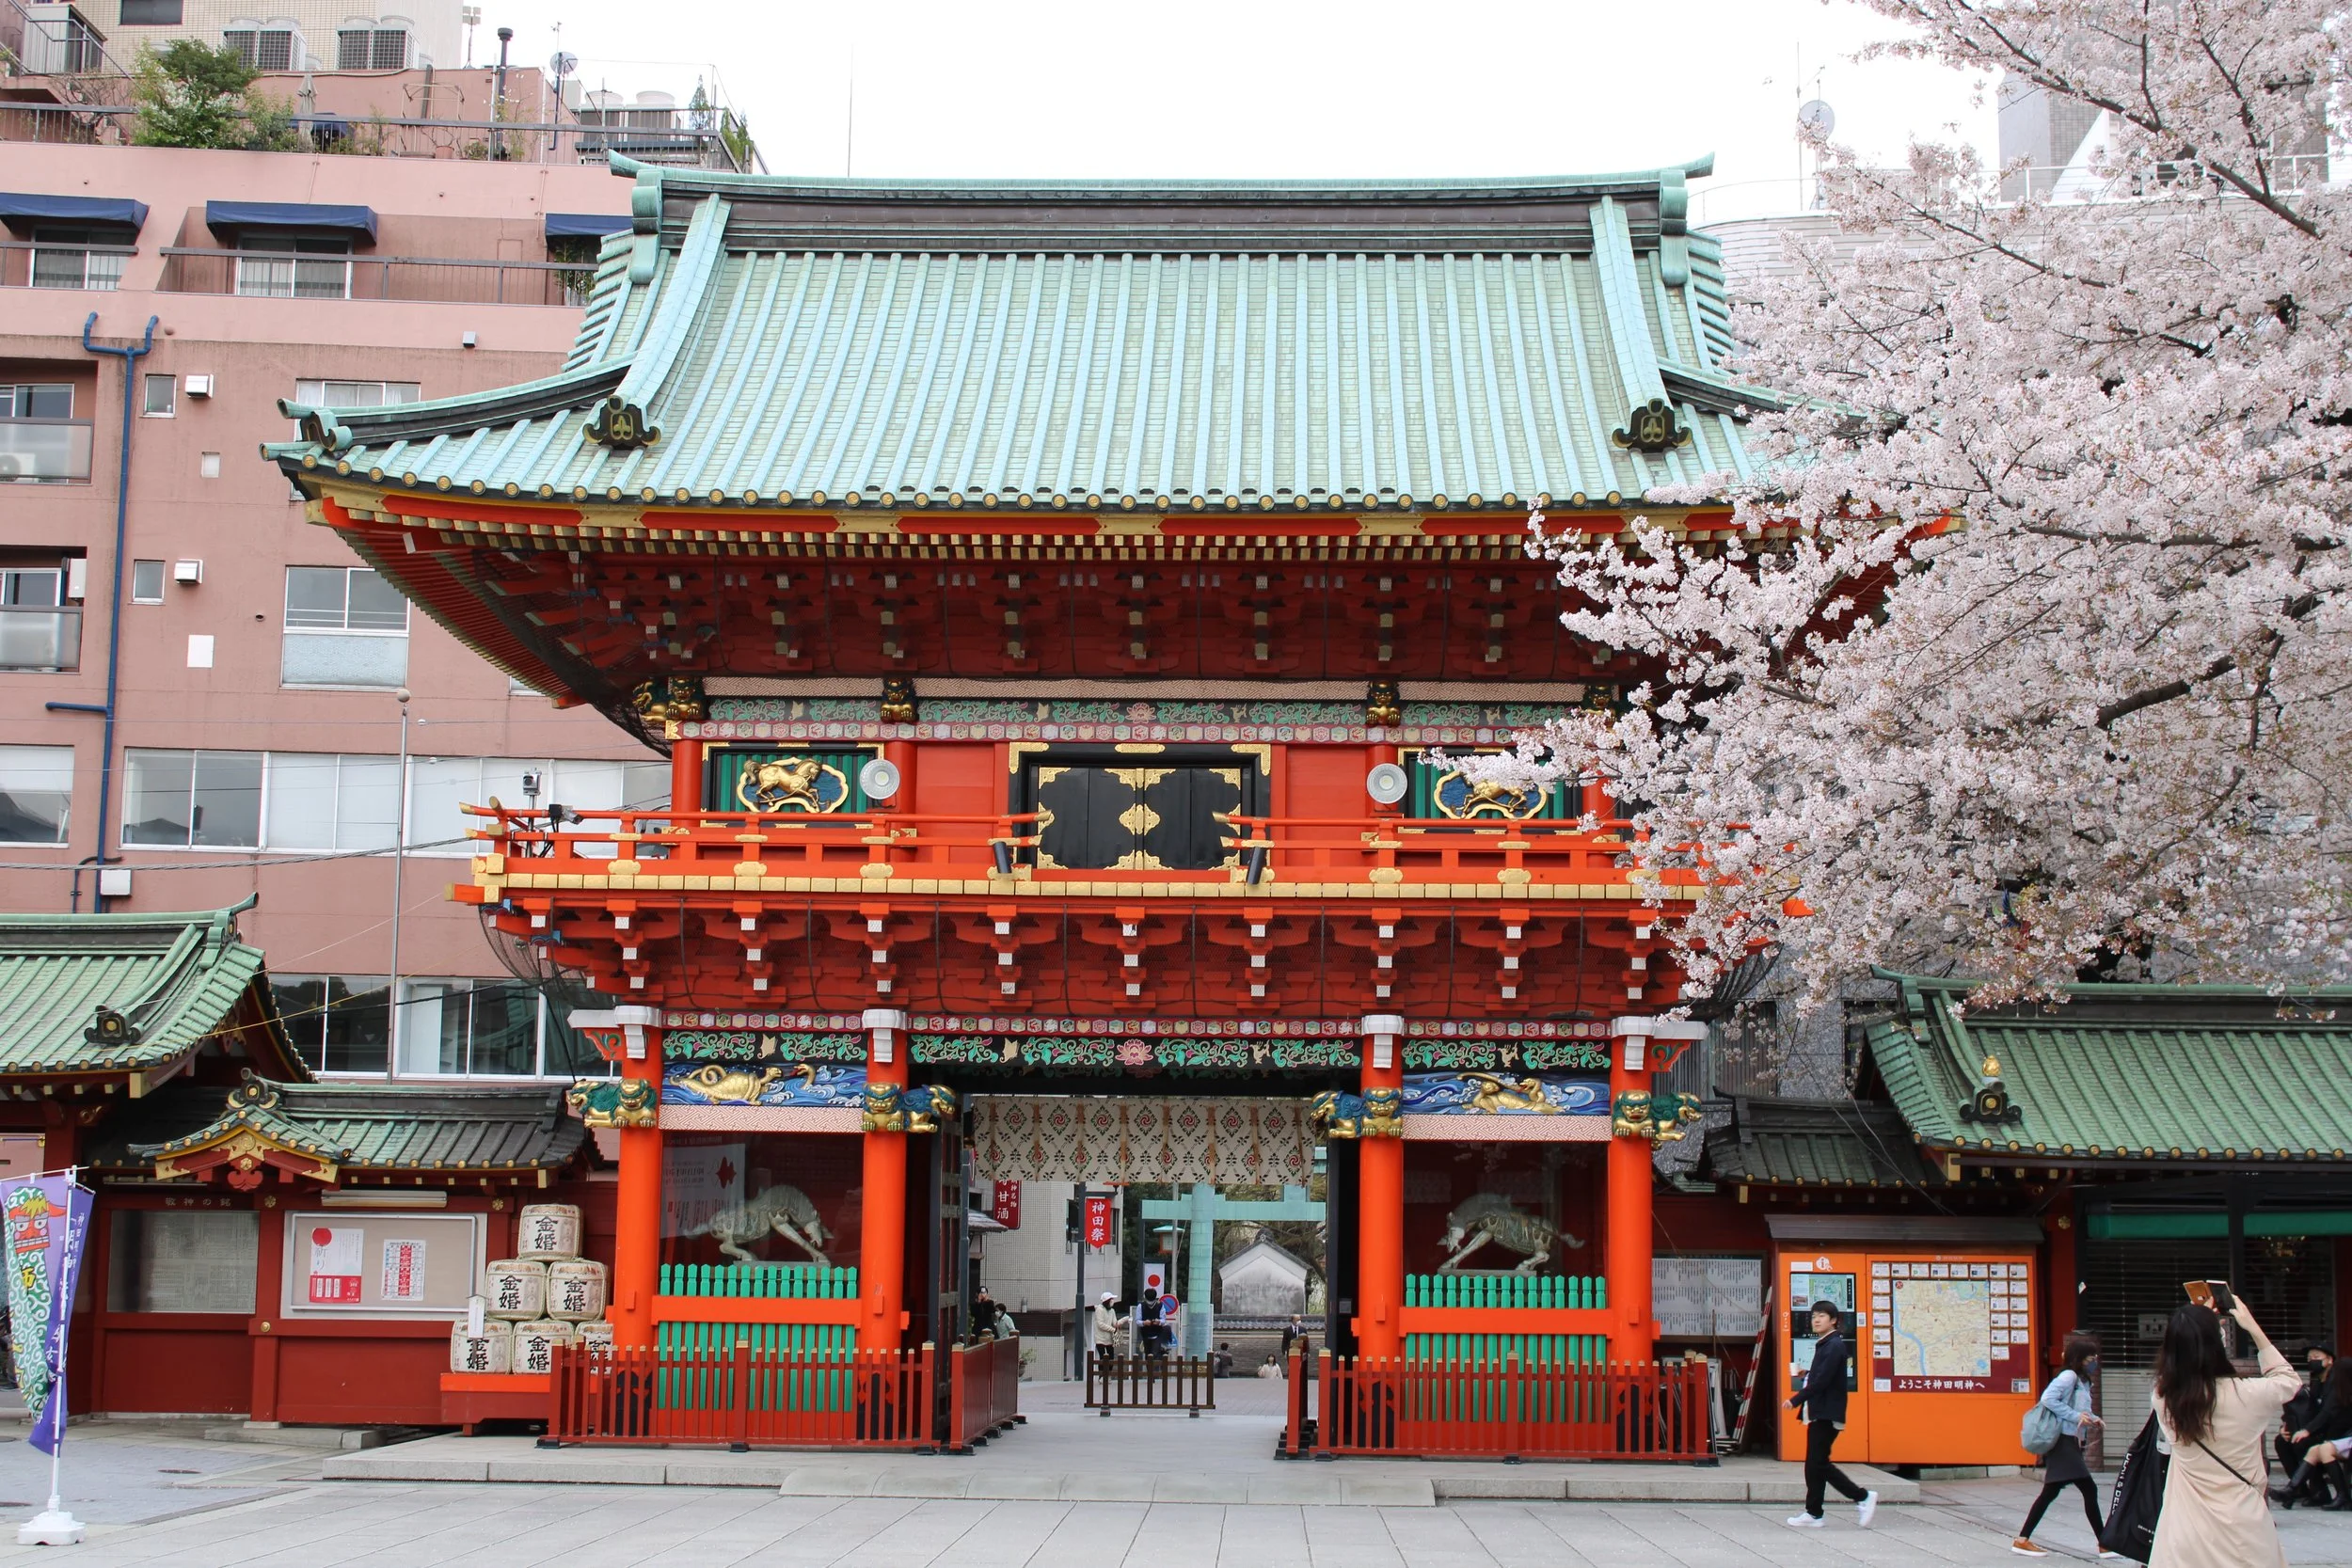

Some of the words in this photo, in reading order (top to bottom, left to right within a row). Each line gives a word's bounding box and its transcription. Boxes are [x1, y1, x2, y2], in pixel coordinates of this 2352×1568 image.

[534, 1215, 558, 1251] 金婚
[1091, 1201, 1105, 1242] 神田祭
[499, 1275, 523, 1309] 金婚
[563, 1275, 587, 1312] 金婚
[527, 1336, 550, 1370] 金婚
[1899, 1379, 1985, 1390] ようこそ神田明神へ
